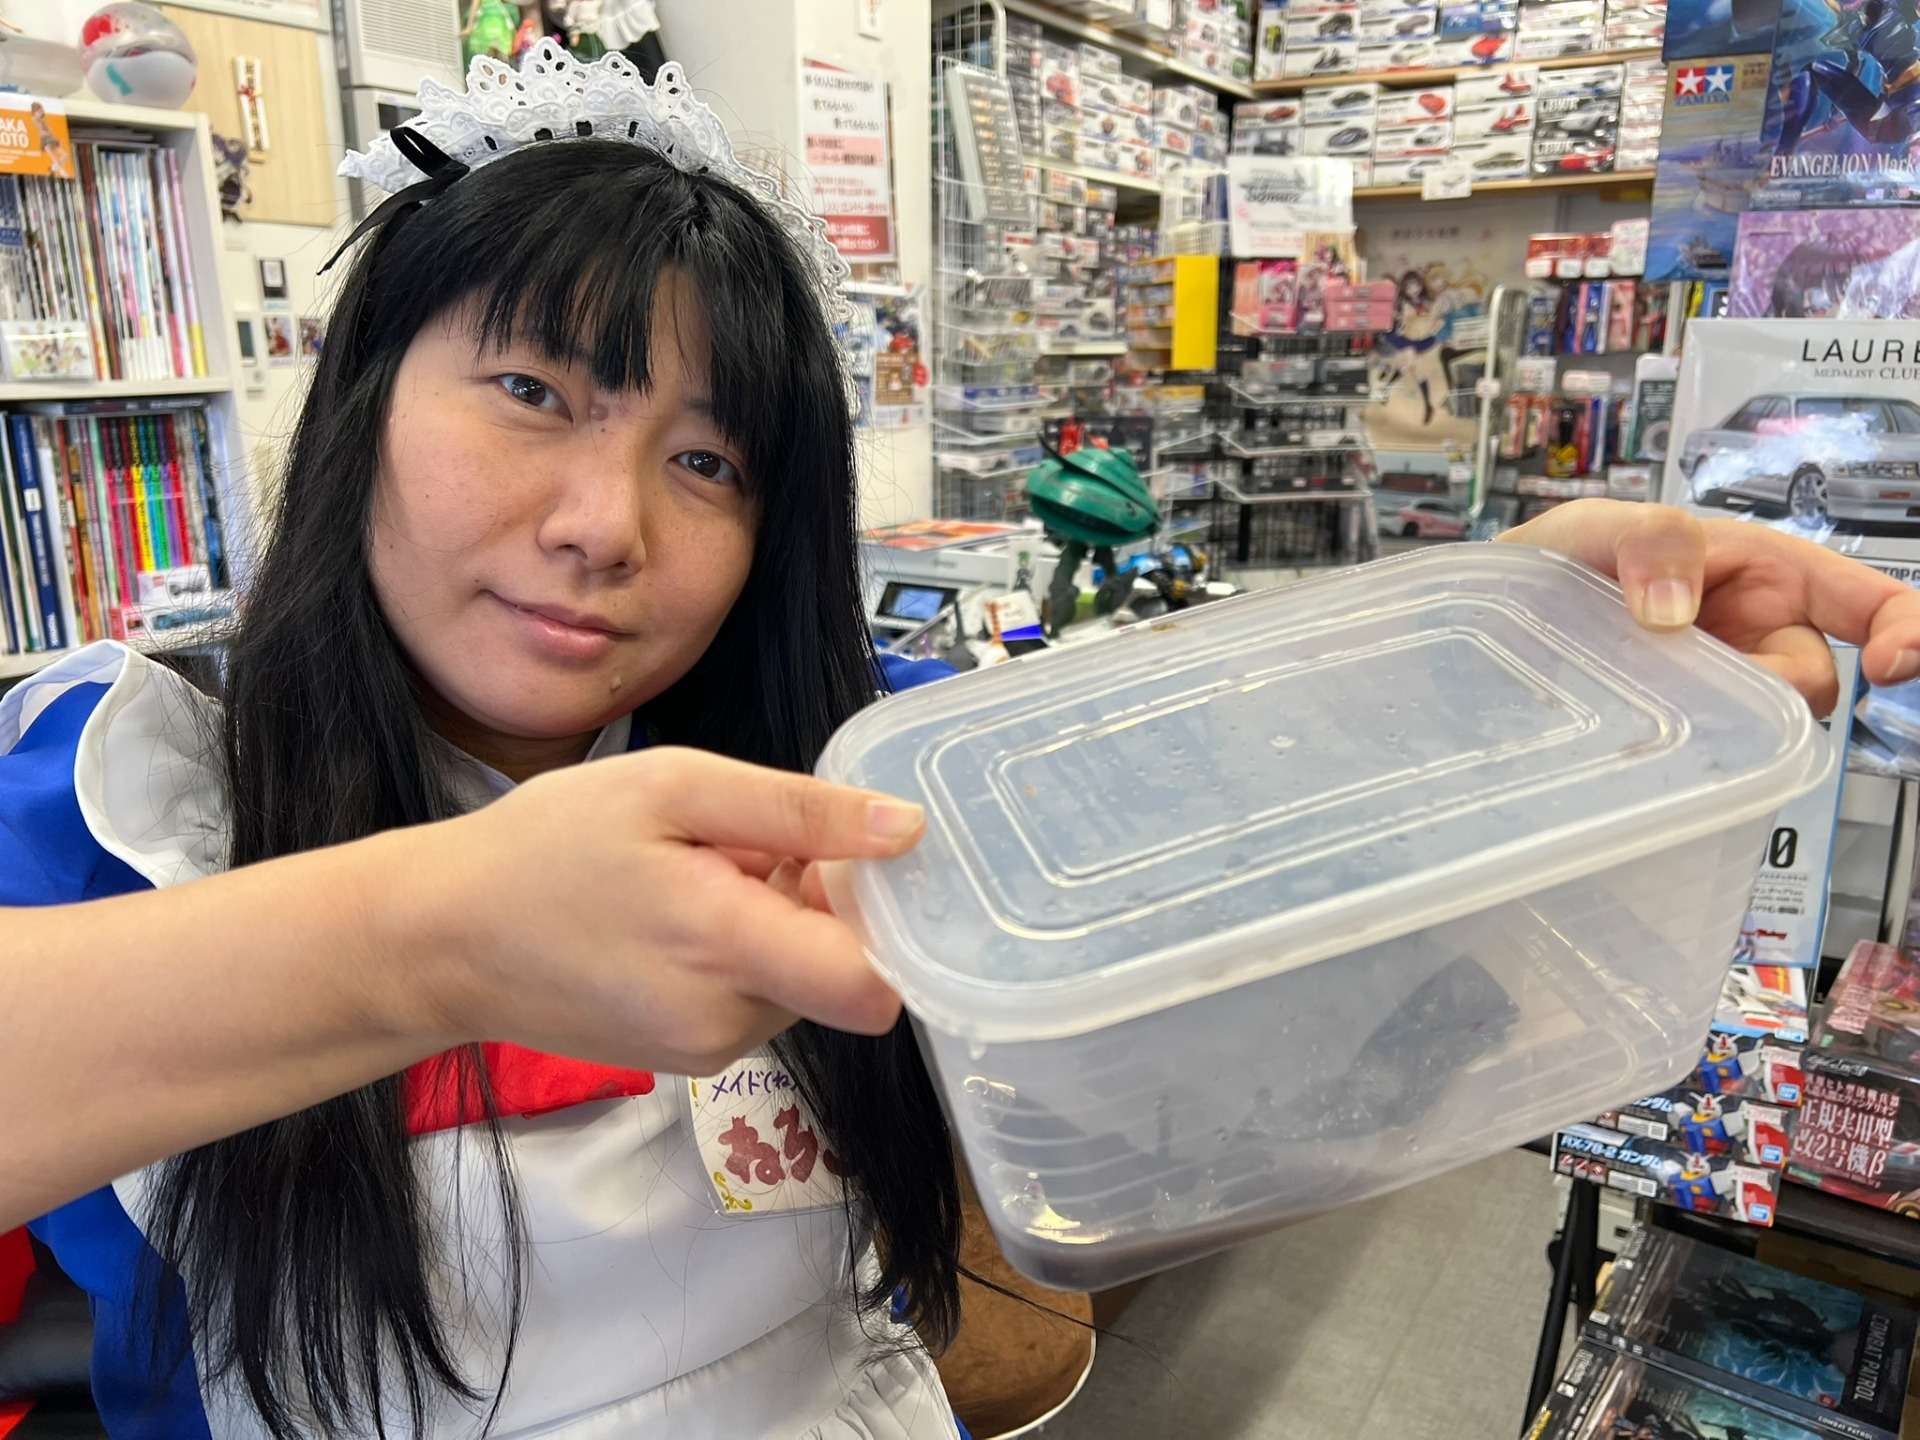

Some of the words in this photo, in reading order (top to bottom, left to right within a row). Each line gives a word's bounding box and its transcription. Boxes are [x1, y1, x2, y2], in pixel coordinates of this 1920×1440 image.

[0, 131, 29, 149] OTO
[1770, 152, 1873, 177] EVANGELION
[1814, 367, 1875, 380] MEDALIST
[1761, 827, 1799, 869] 0
[1617, 1150, 1663, 1168] ガンダム
[1863, 1313, 1891, 1359] COMBAT
[1853, 1358, 1882, 1402] PATROL
[1817, 1414, 1847, 1432] COMBAT
[1846, 1425, 1874, 1440] PATROL
